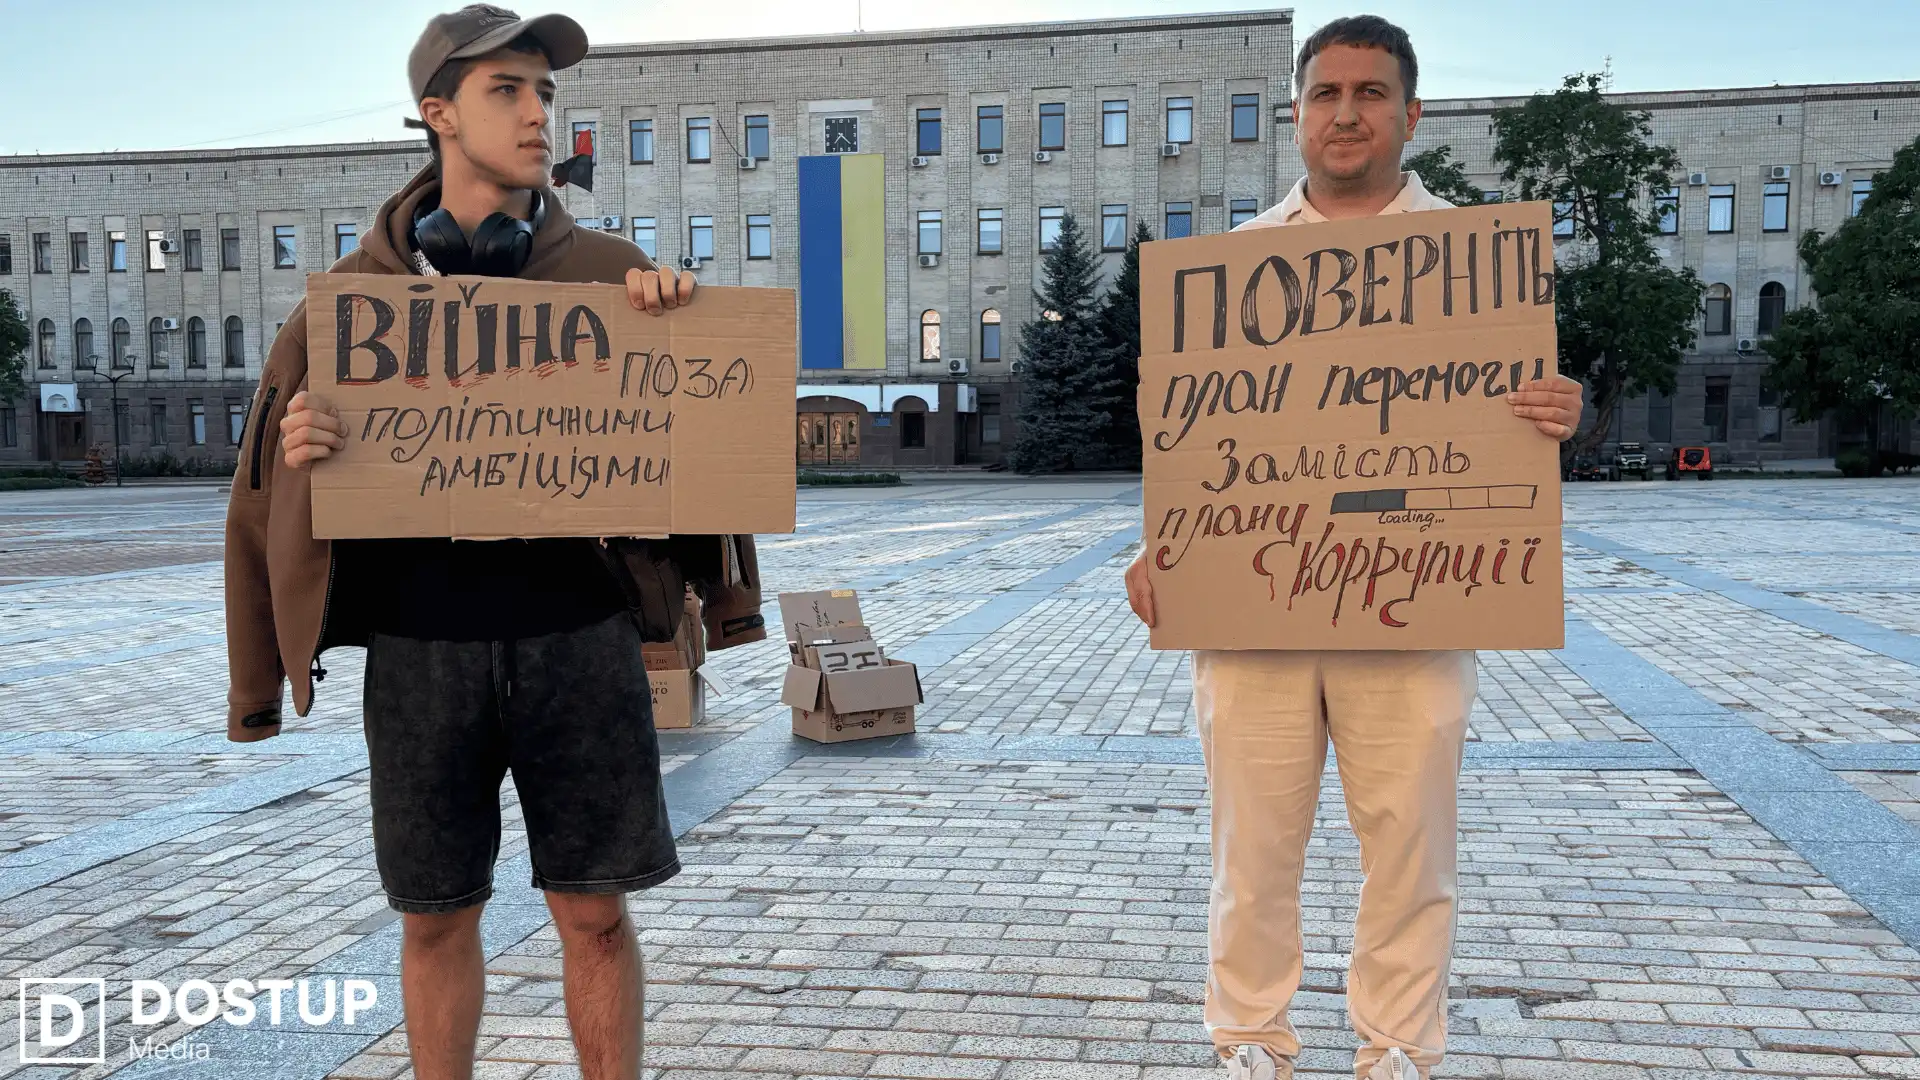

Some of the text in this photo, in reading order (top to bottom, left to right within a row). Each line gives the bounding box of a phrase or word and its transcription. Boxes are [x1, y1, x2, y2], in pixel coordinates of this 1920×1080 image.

[1172, 219, 1556, 353] ПОВЕРНІТЬ
[336, 282, 755, 399] ВІЙНА ПОЗА
[1154, 361, 1293, 452] план
[1201, 438, 1471, 494] Замість
[1156, 503, 1310, 578] плану
